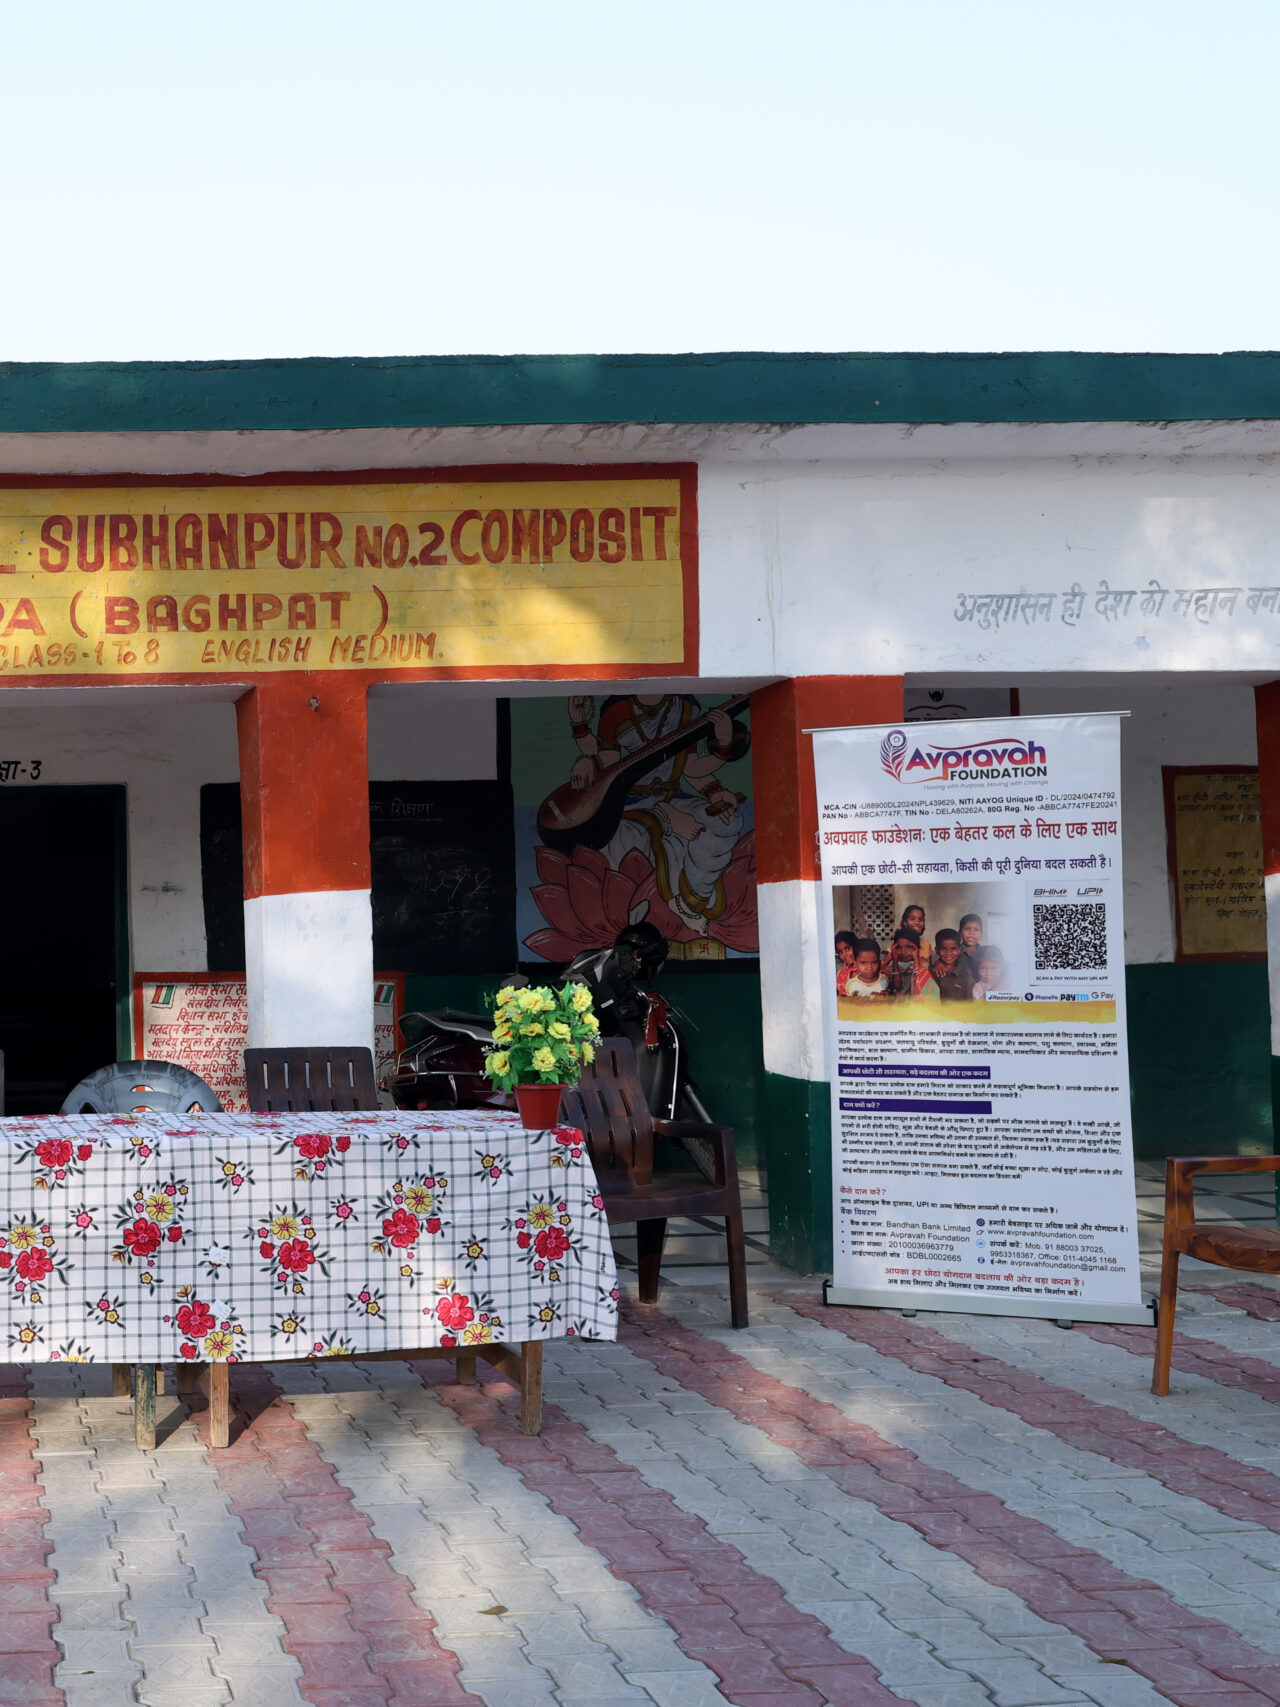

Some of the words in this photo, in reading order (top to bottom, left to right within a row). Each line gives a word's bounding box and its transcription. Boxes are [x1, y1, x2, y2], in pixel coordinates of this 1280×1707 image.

[39, 511, 343, 573] SUBHANPUR
[355, 521, 448, 570] NO.2
[450, 506, 678, 565] COMPOSIT
[953, 592, 1057, 629] अनुशासन
[1061, 583, 1087, 627] ही
[1095, 579, 1137, 622] देश
[1140, 579, 1169, 617] को
[1173, 587, 1243, 624] महान
[144, 639, 160, 664] 8
[201, 635, 312, 664] ENGLISH
[905, 741, 1047, 781] Avpravah
[950, 766, 1047, 781] FOUNDATION
[1006, 796, 1034, 804] Unique
[823, 831, 868, 845] अवप्रवाह
[930, 827, 951, 843] एक
[954, 821, 988, 842] बेहतर
[992, 825, 1015, 840] कल
[1020, 818, 1032, 839] के
[1036, 818, 1061, 839] लिए
[1066, 822, 1087, 839] एक
[1092, 821, 1118, 836] साथ
[831, 861, 858, 876] आपकी
[861, 865, 876, 875] एक
[878, 860, 913, 874] छोटी-सी
[916, 862, 953, 874] सहायता,
[956, 858, 978, 872] किसी
[981, 857, 993, 871] की
[996, 856, 1011, 874] पूरी
[1014, 856, 1042, 875] दुनिया
[1045, 859, 1066, 870] बदल
[1069, 854, 1097, 869] सकती
[1033, 888, 1064, 896] BHIM
[1077, 887, 1099, 896] UPI
[1060, 993, 1089, 1001] paytm
[1101, 992, 1114, 1000] Pay
[886, 1221, 920, 1229] Bandhan
[943, 1224, 971, 1232] Limited
[890, 1232, 926, 1240] Avpravah
[928, 1233, 970, 1242] Foundation
